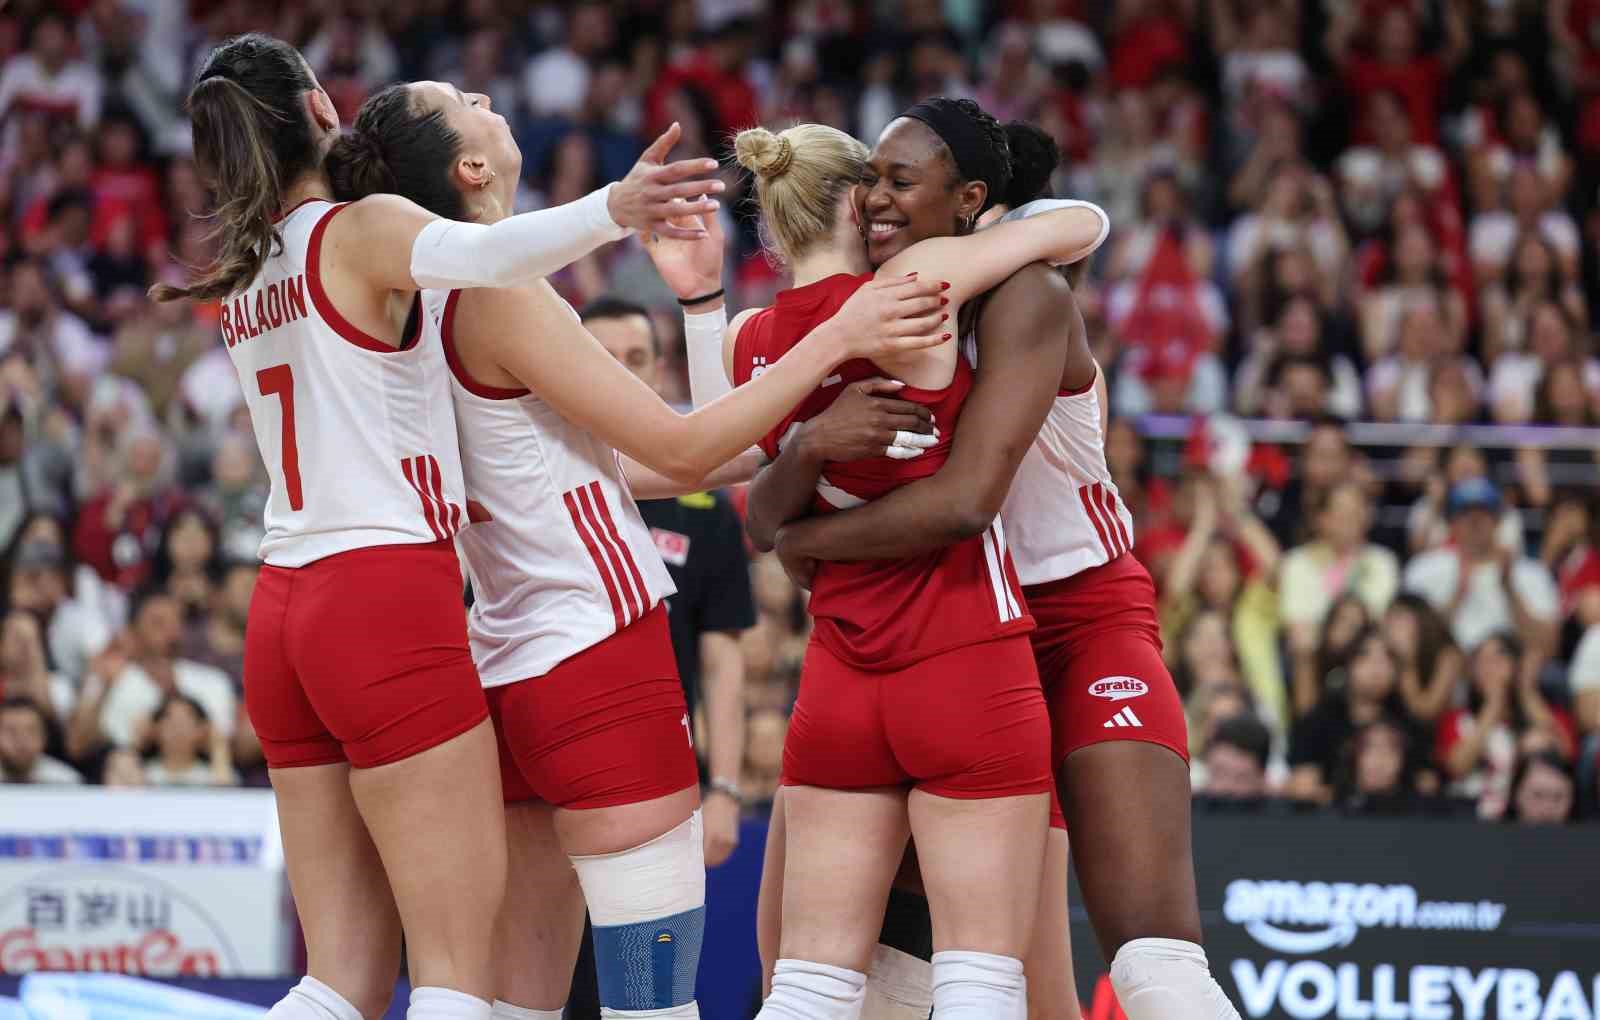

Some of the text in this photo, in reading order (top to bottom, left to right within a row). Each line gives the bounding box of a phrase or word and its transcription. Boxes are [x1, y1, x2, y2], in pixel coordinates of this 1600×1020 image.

[222, 274, 308, 348] BALADIN
[256, 363, 304, 511] 7
[1094, 680, 1143, 694] gratis
